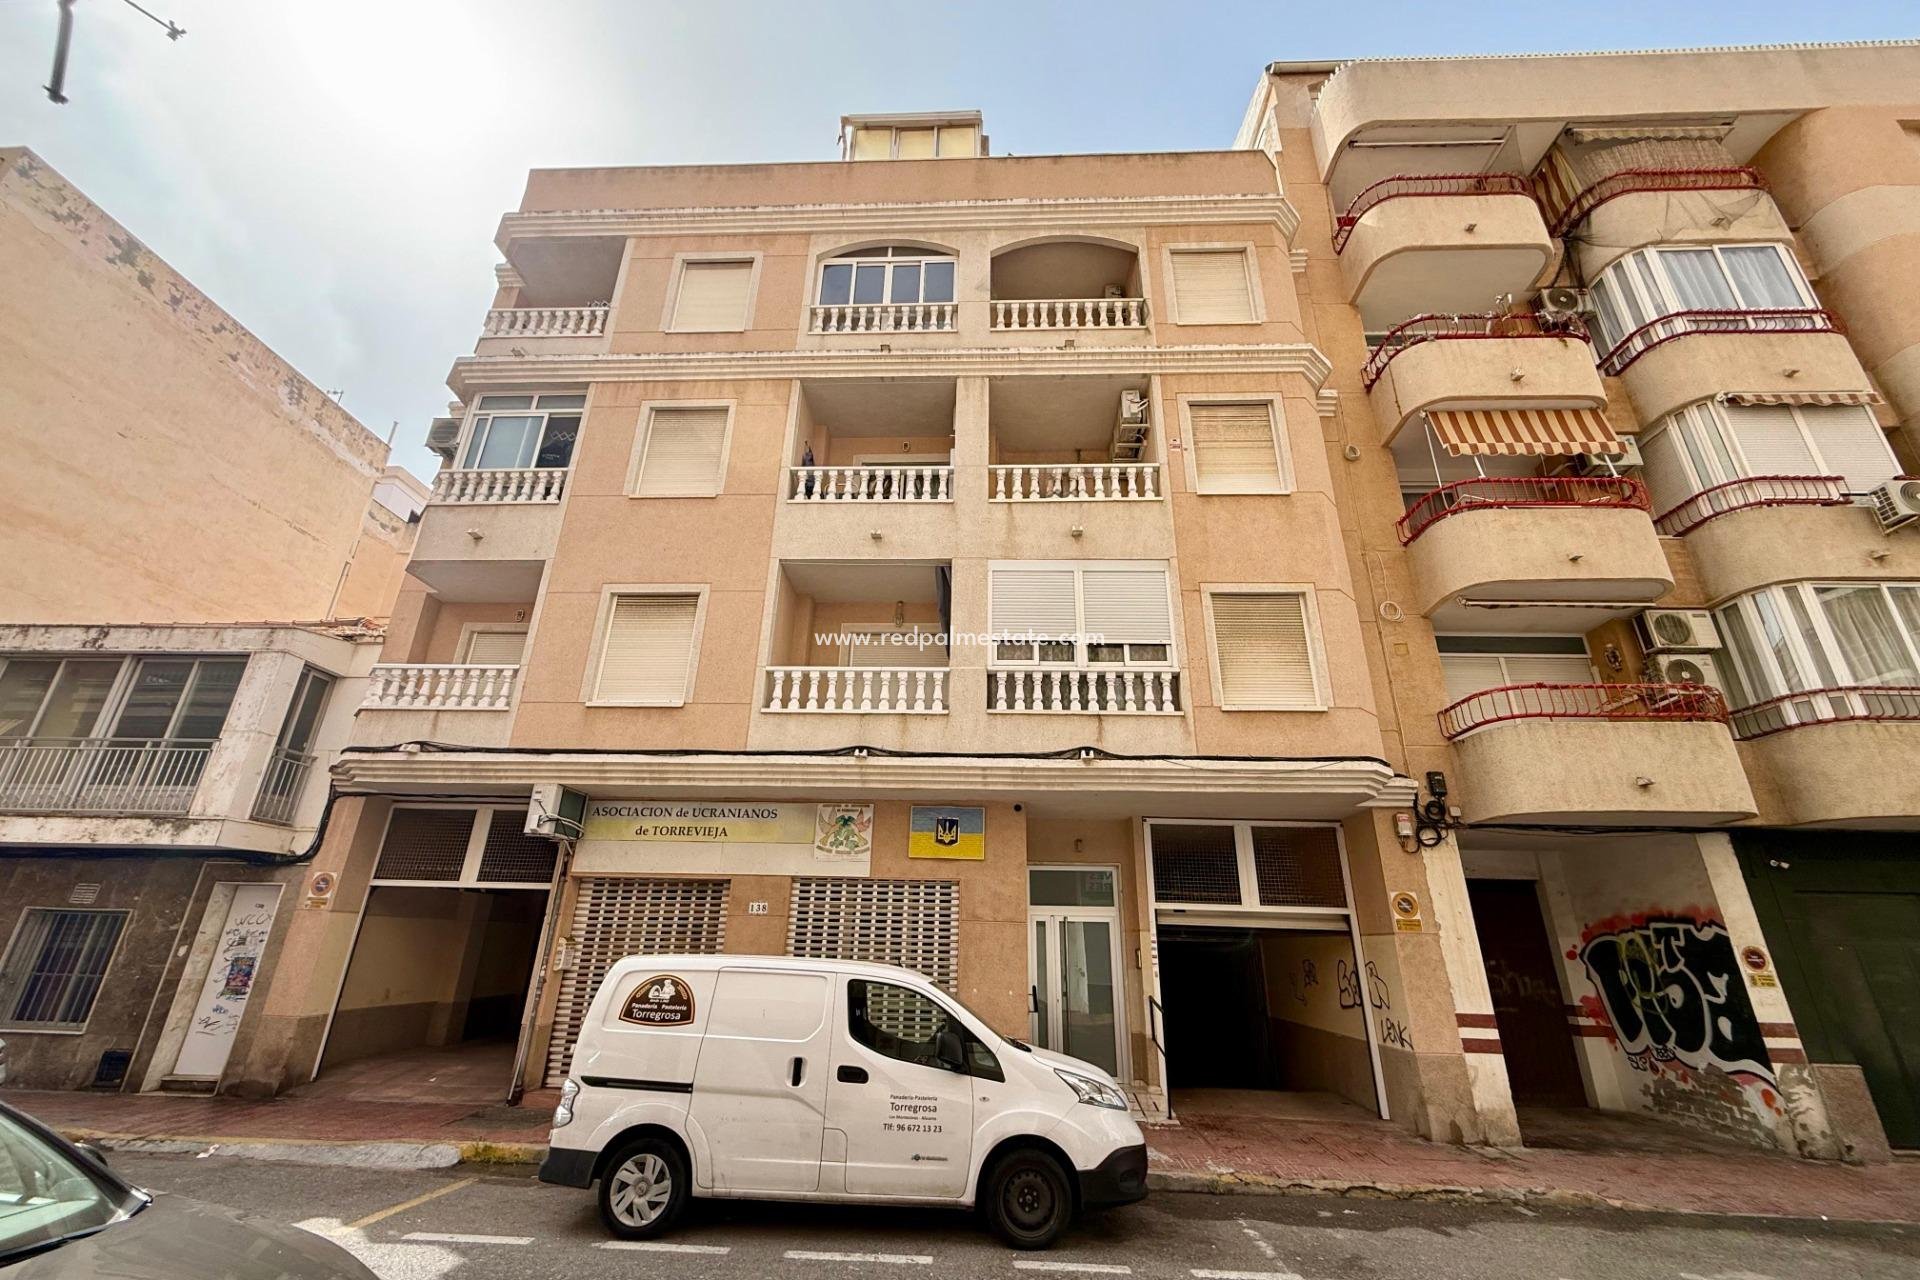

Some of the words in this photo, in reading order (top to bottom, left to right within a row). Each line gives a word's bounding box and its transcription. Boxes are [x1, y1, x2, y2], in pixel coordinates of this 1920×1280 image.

[592, 806, 673, 817] ASOCIACION
[675, 807, 689, 817] de
[692, 807, 778, 819] UCRANIANOS
[635, 825, 648, 836] de
[652, 825, 728, 839] TORREVIEJA
[750, 904, 767, 912] 138
[632, 1009, 681, 1021] Torregrosa
[890, 1102, 938, 1114] Torregrosa
[896, 1123, 906, 1132] 96
[907, 1124, 921, 1132] 672
[923, 1125, 932, 1133] 13
[933, 1125, 942, 1133] 23
